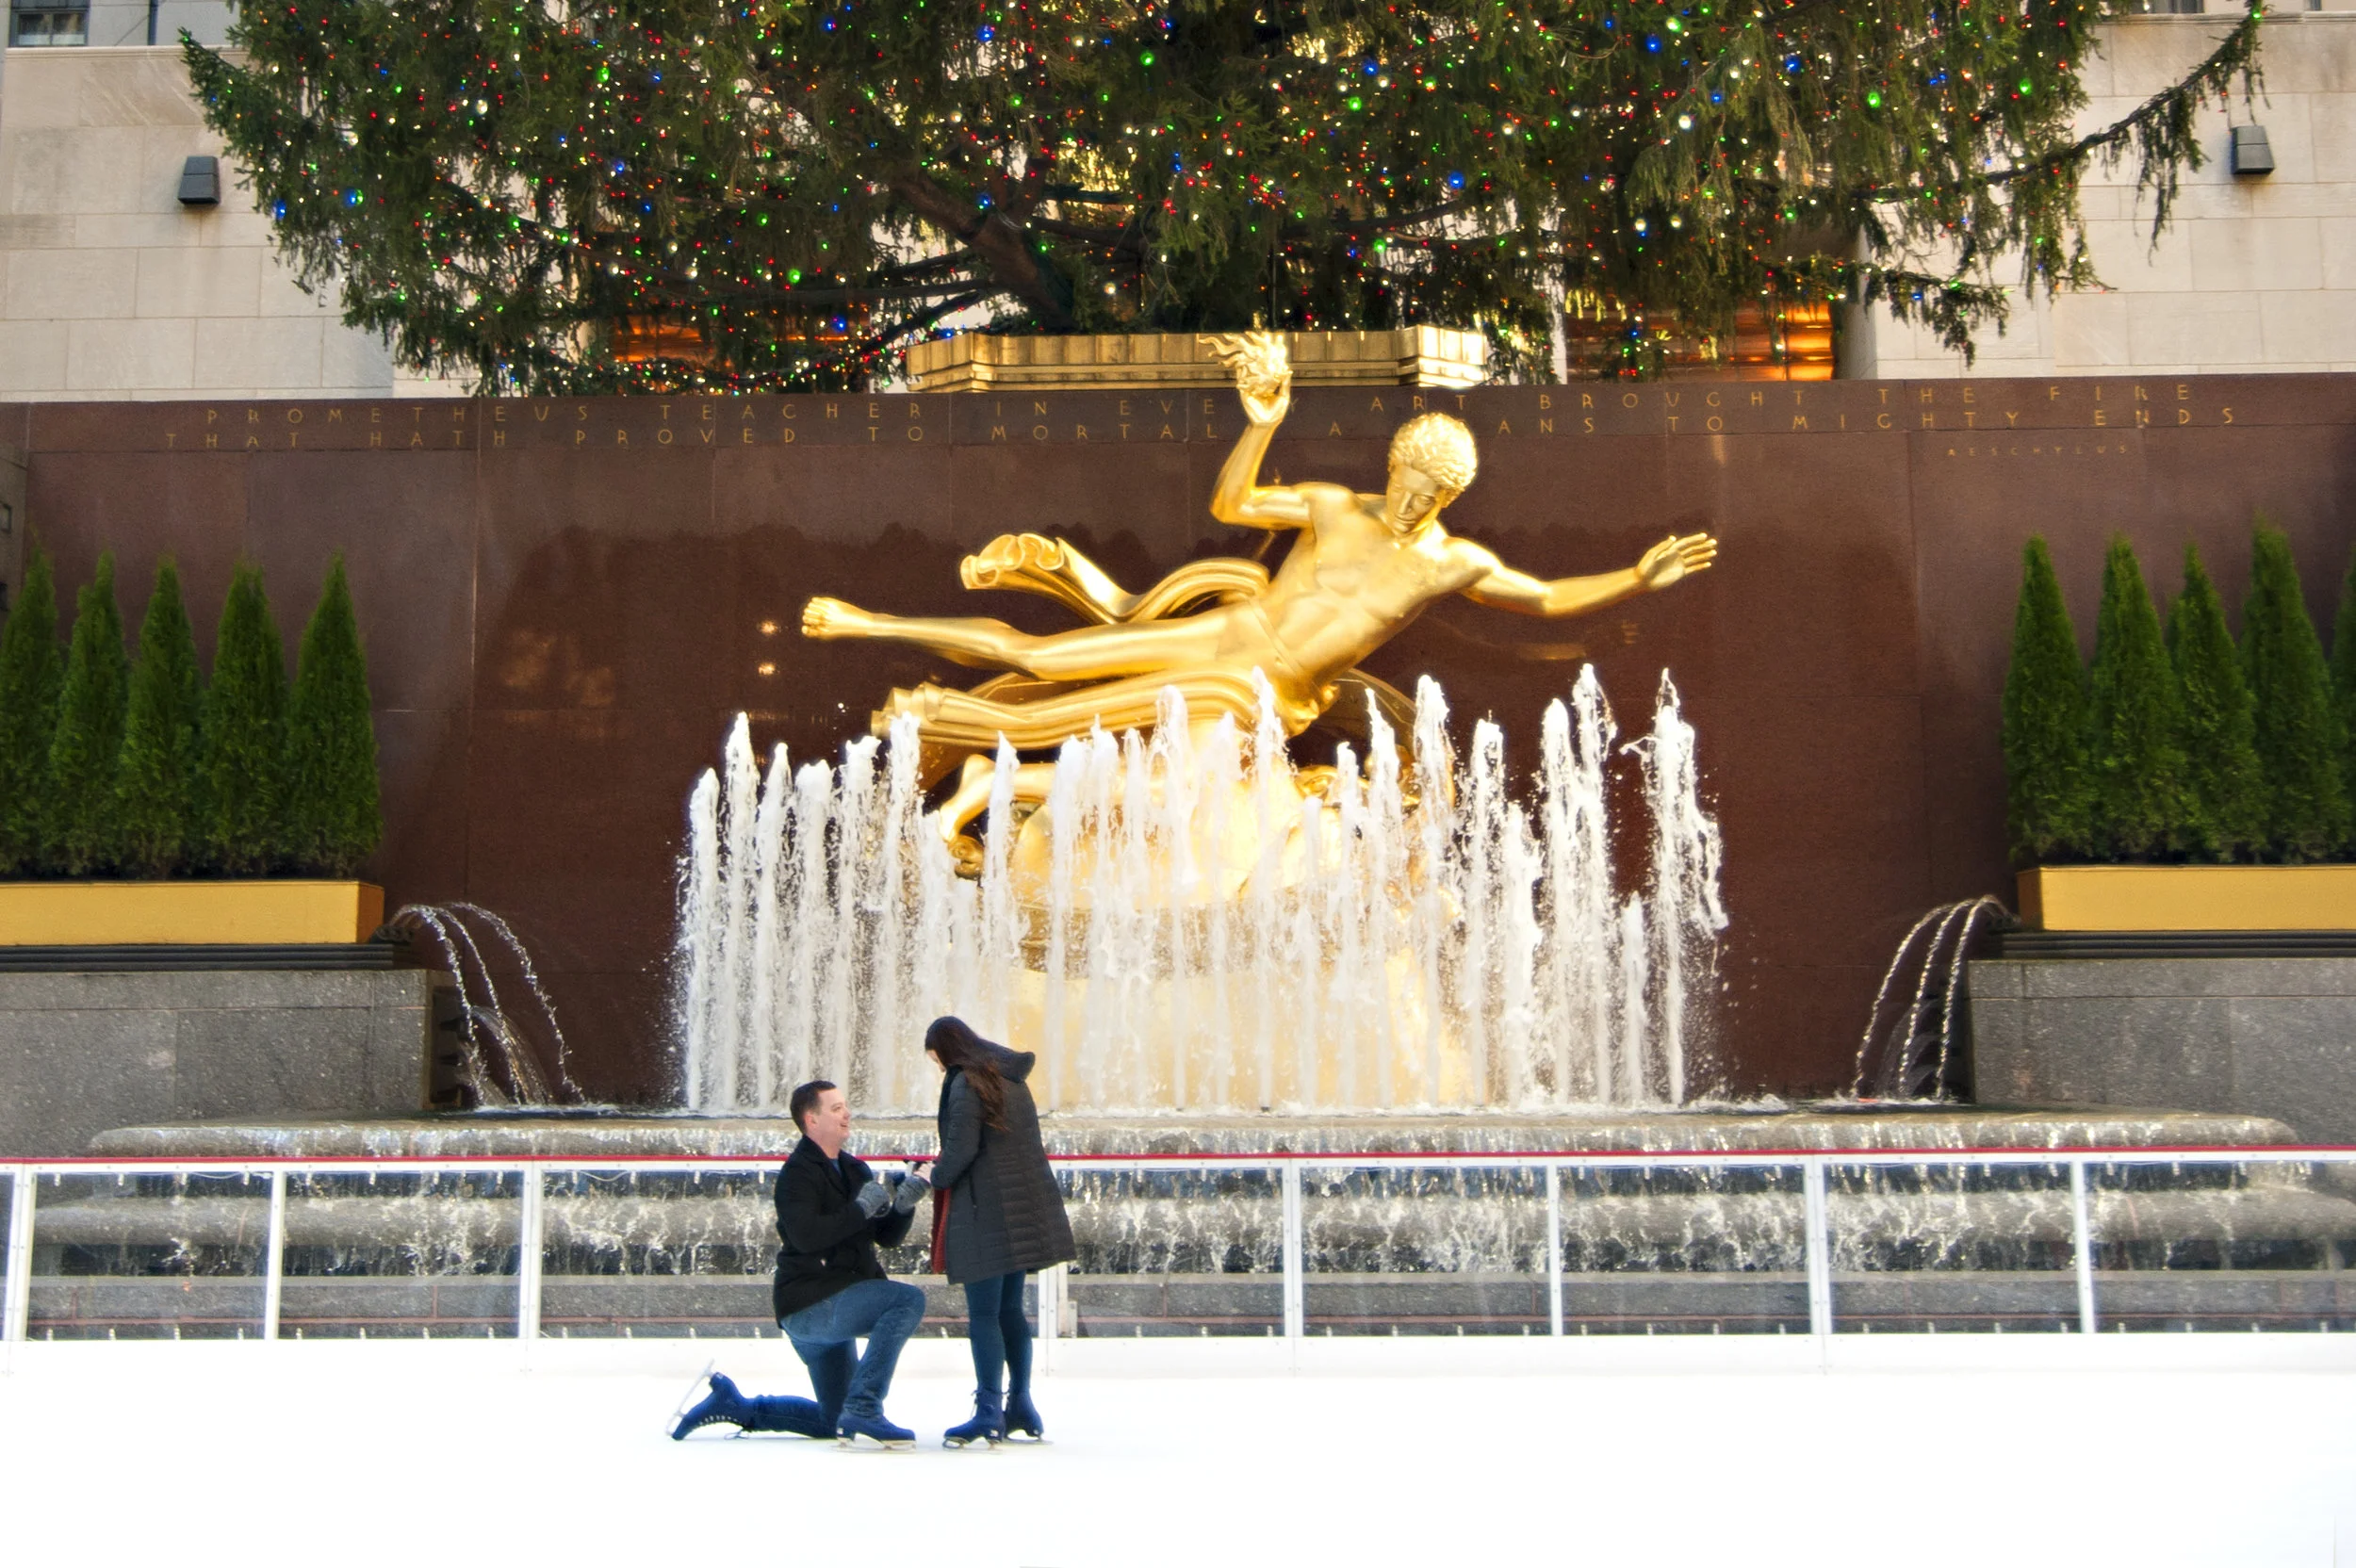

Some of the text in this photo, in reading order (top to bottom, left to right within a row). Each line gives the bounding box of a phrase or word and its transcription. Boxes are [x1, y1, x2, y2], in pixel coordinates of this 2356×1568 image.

[206, 384, 2189, 424] PROMETHEUS TEACHER IN EVEY ART BROUGHT THE FIRE
[166, 432, 302, 449] THAT
[369, 430, 507, 448] HATH
[576, 428, 797, 446] PROVED
[867, 425, 924, 442] TO
[990, 423, 1249, 442] MORTAL
[1665, 415, 1724, 433] TO
[1792, 411, 2019, 432] MIGHTY
[2093, 408, 2234, 426] ENDS
[1947, 445, 2127, 457] AESCHYLUS
